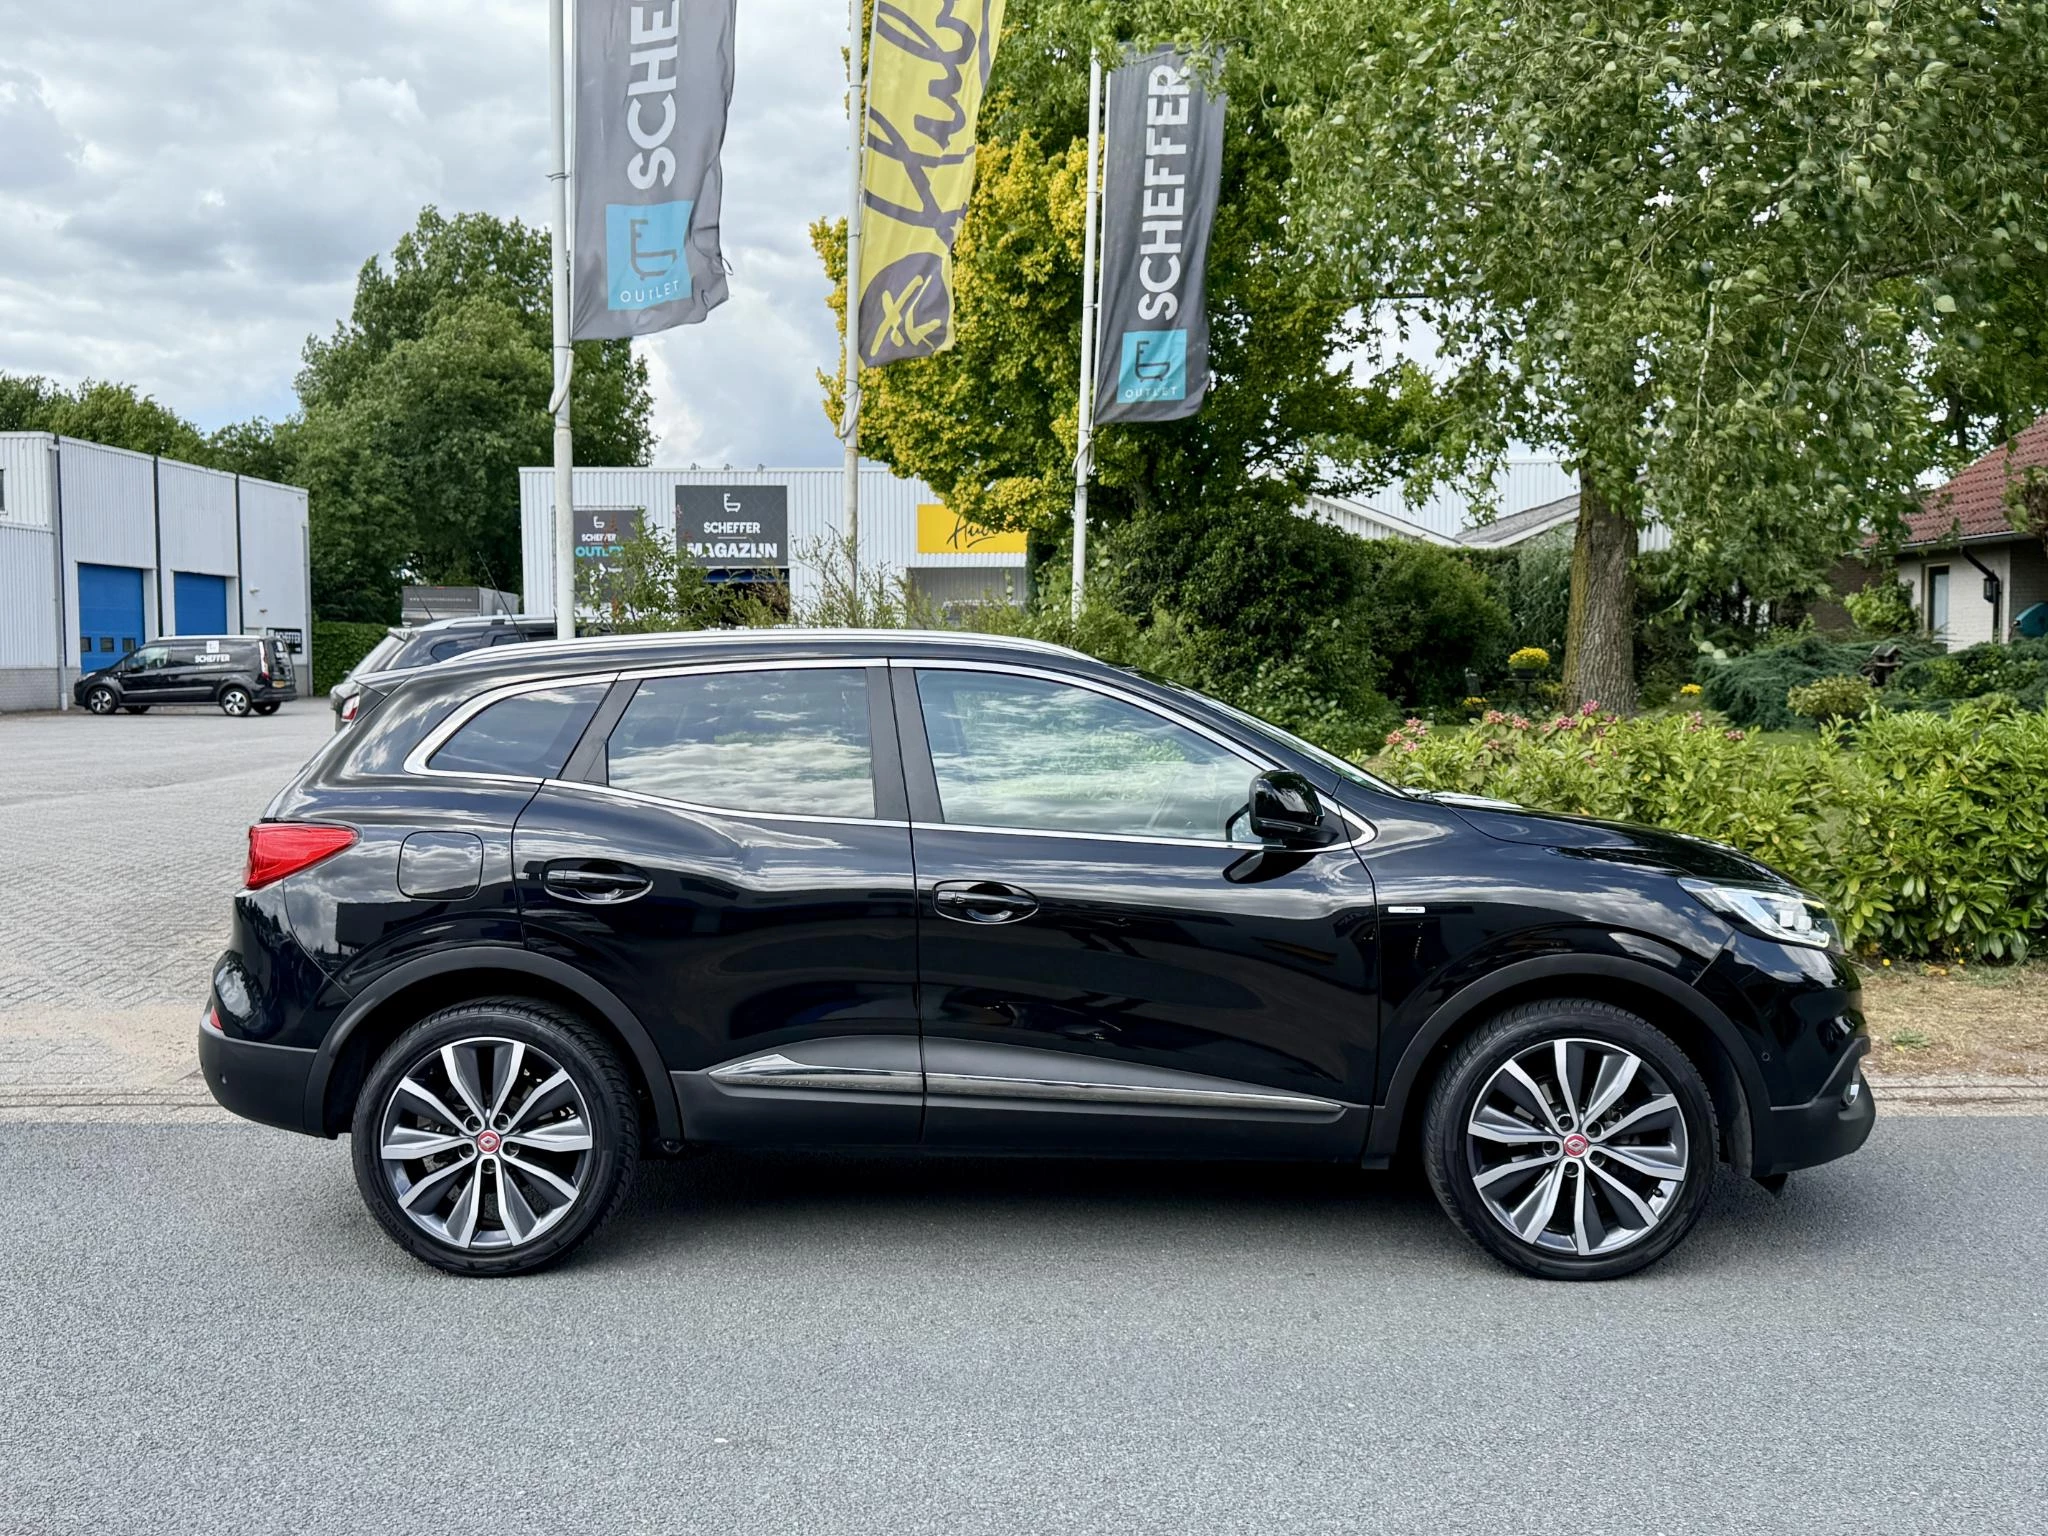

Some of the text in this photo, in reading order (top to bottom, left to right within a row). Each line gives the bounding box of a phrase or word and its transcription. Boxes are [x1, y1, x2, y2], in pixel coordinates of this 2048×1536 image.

[1137, 64, 1191, 321] SCHEFFER
[1125, 386, 1177, 398] OUTLET
[703, 521, 761, 534] SCHEFFER
